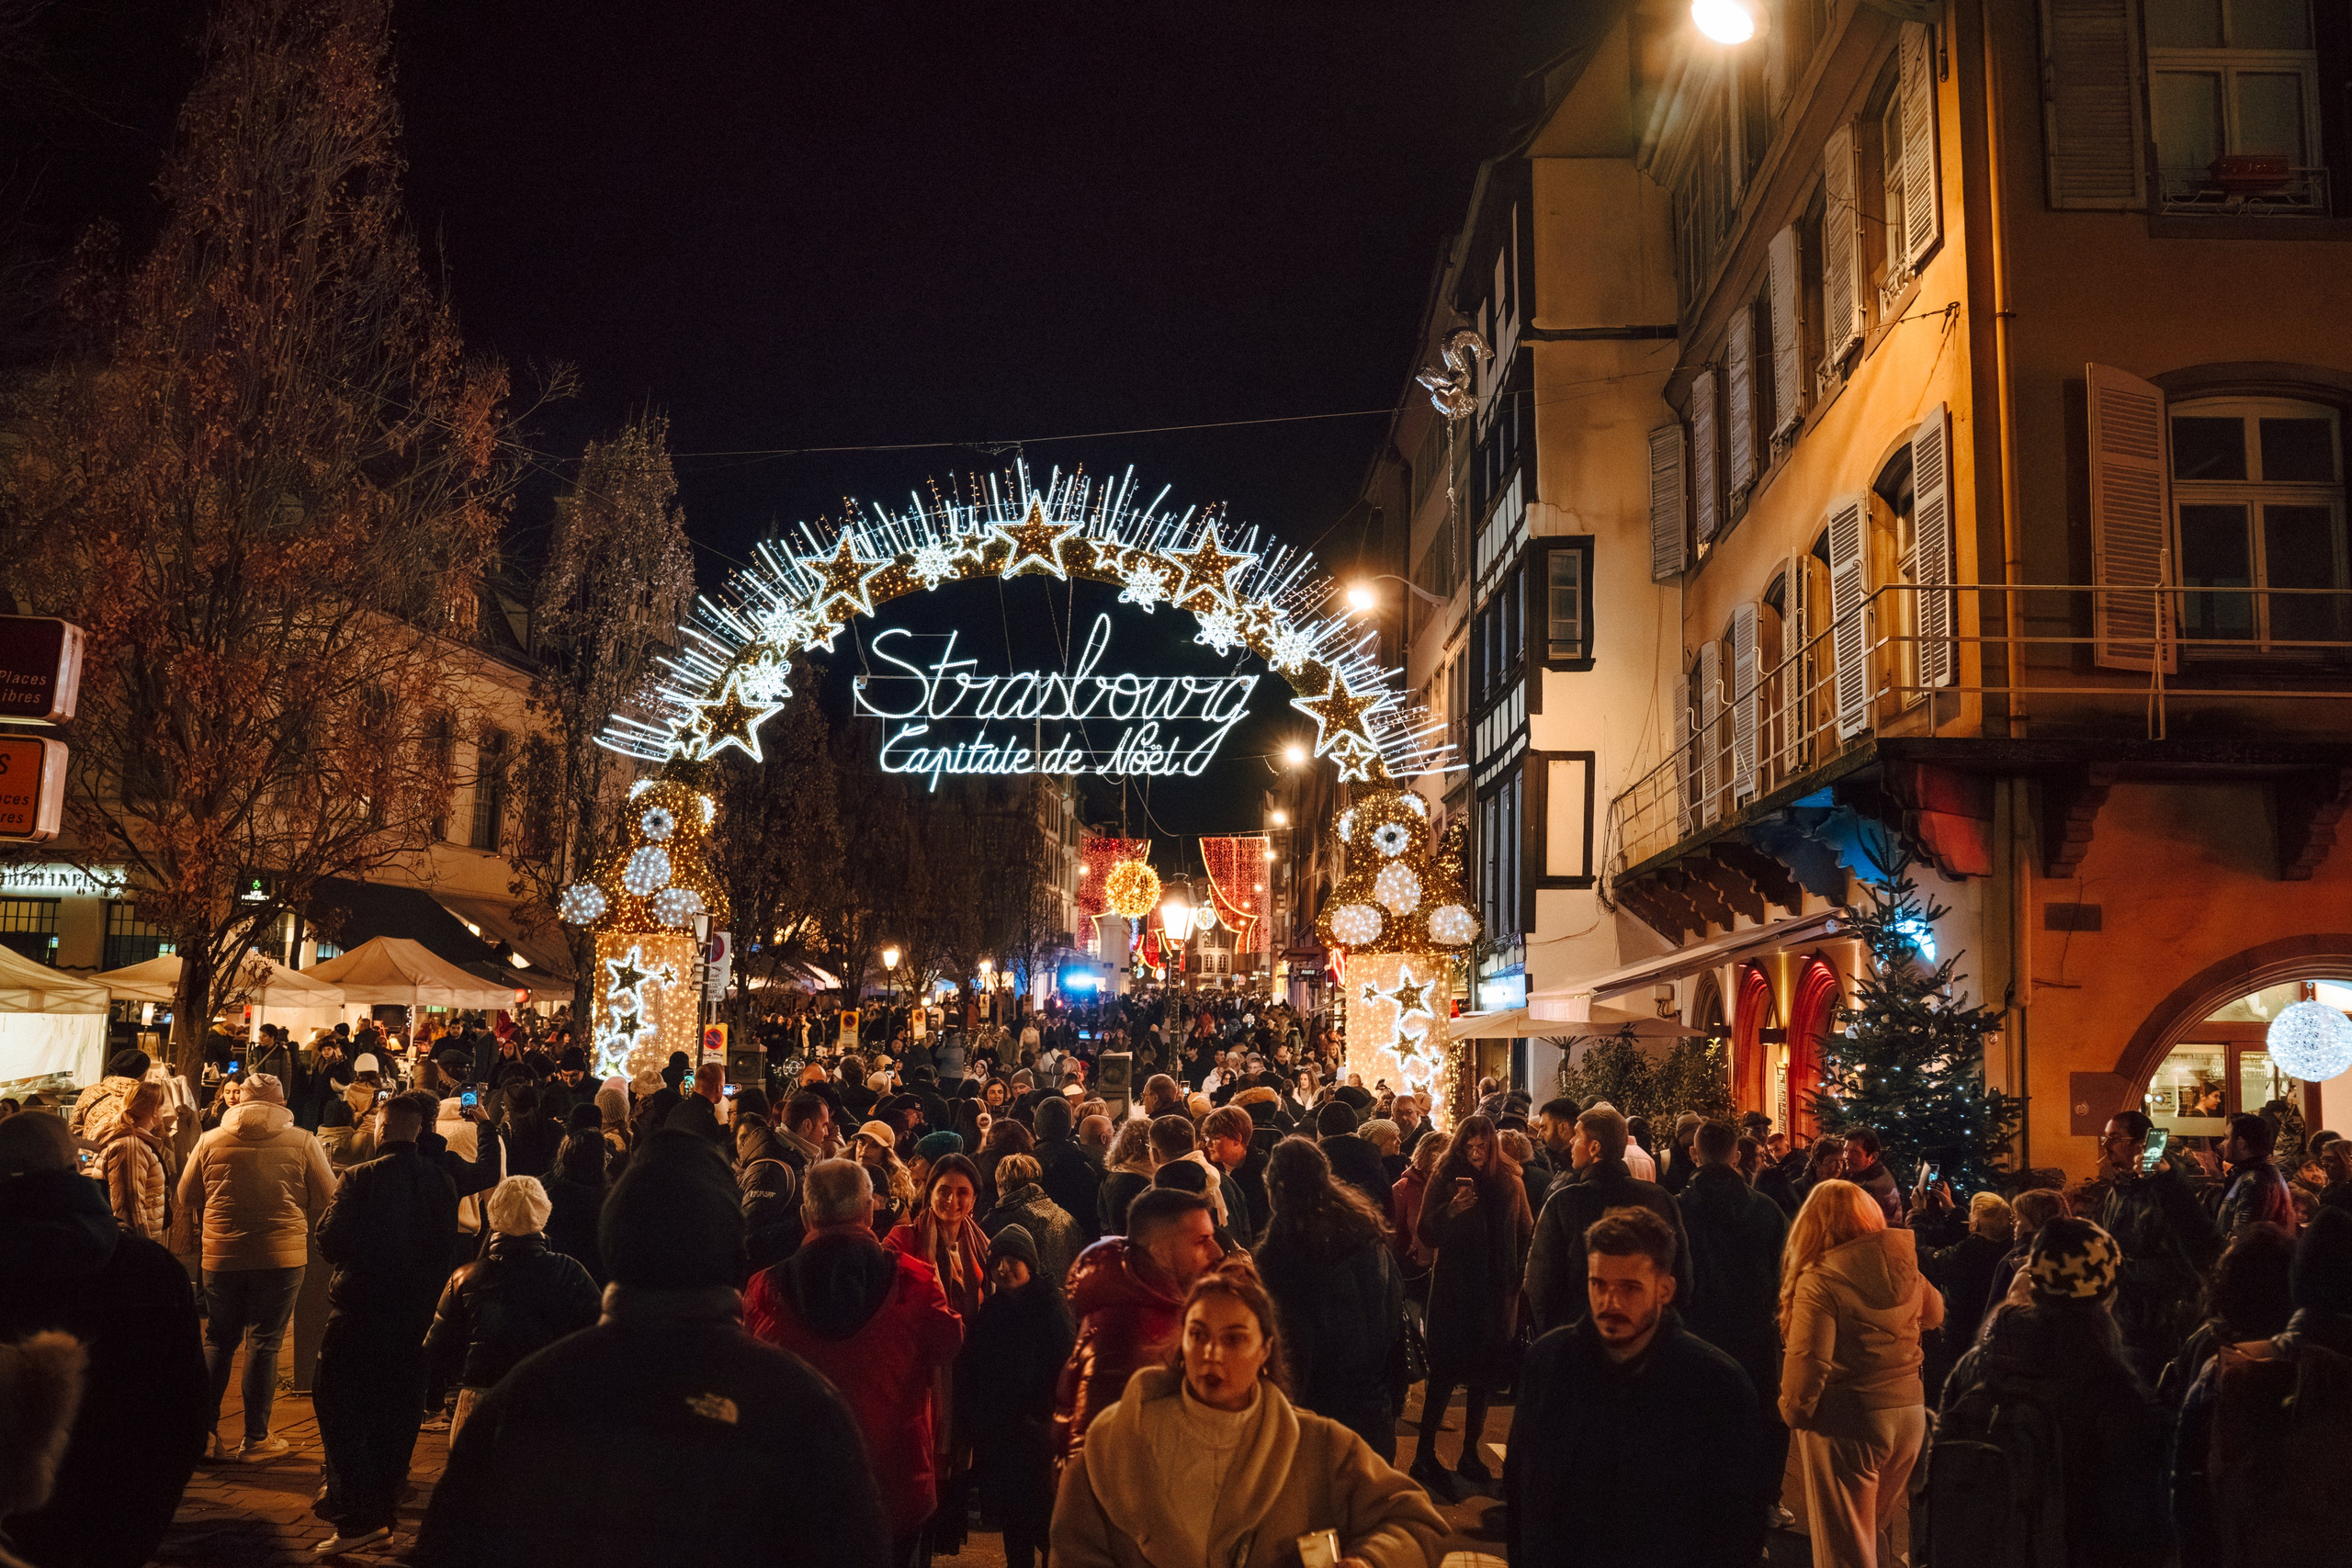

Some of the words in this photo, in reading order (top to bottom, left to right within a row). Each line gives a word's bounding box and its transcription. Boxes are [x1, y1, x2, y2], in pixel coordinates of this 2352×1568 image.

[0, 670, 47, 685] Places
[2, 688, 41, 704] ibres
[853, 613, 1260, 776] Strasbourg
[880, 723, 1035, 793] Capitale
[1042, 732, 1086, 774] de
[1097, 721, 1182, 776] Noël
